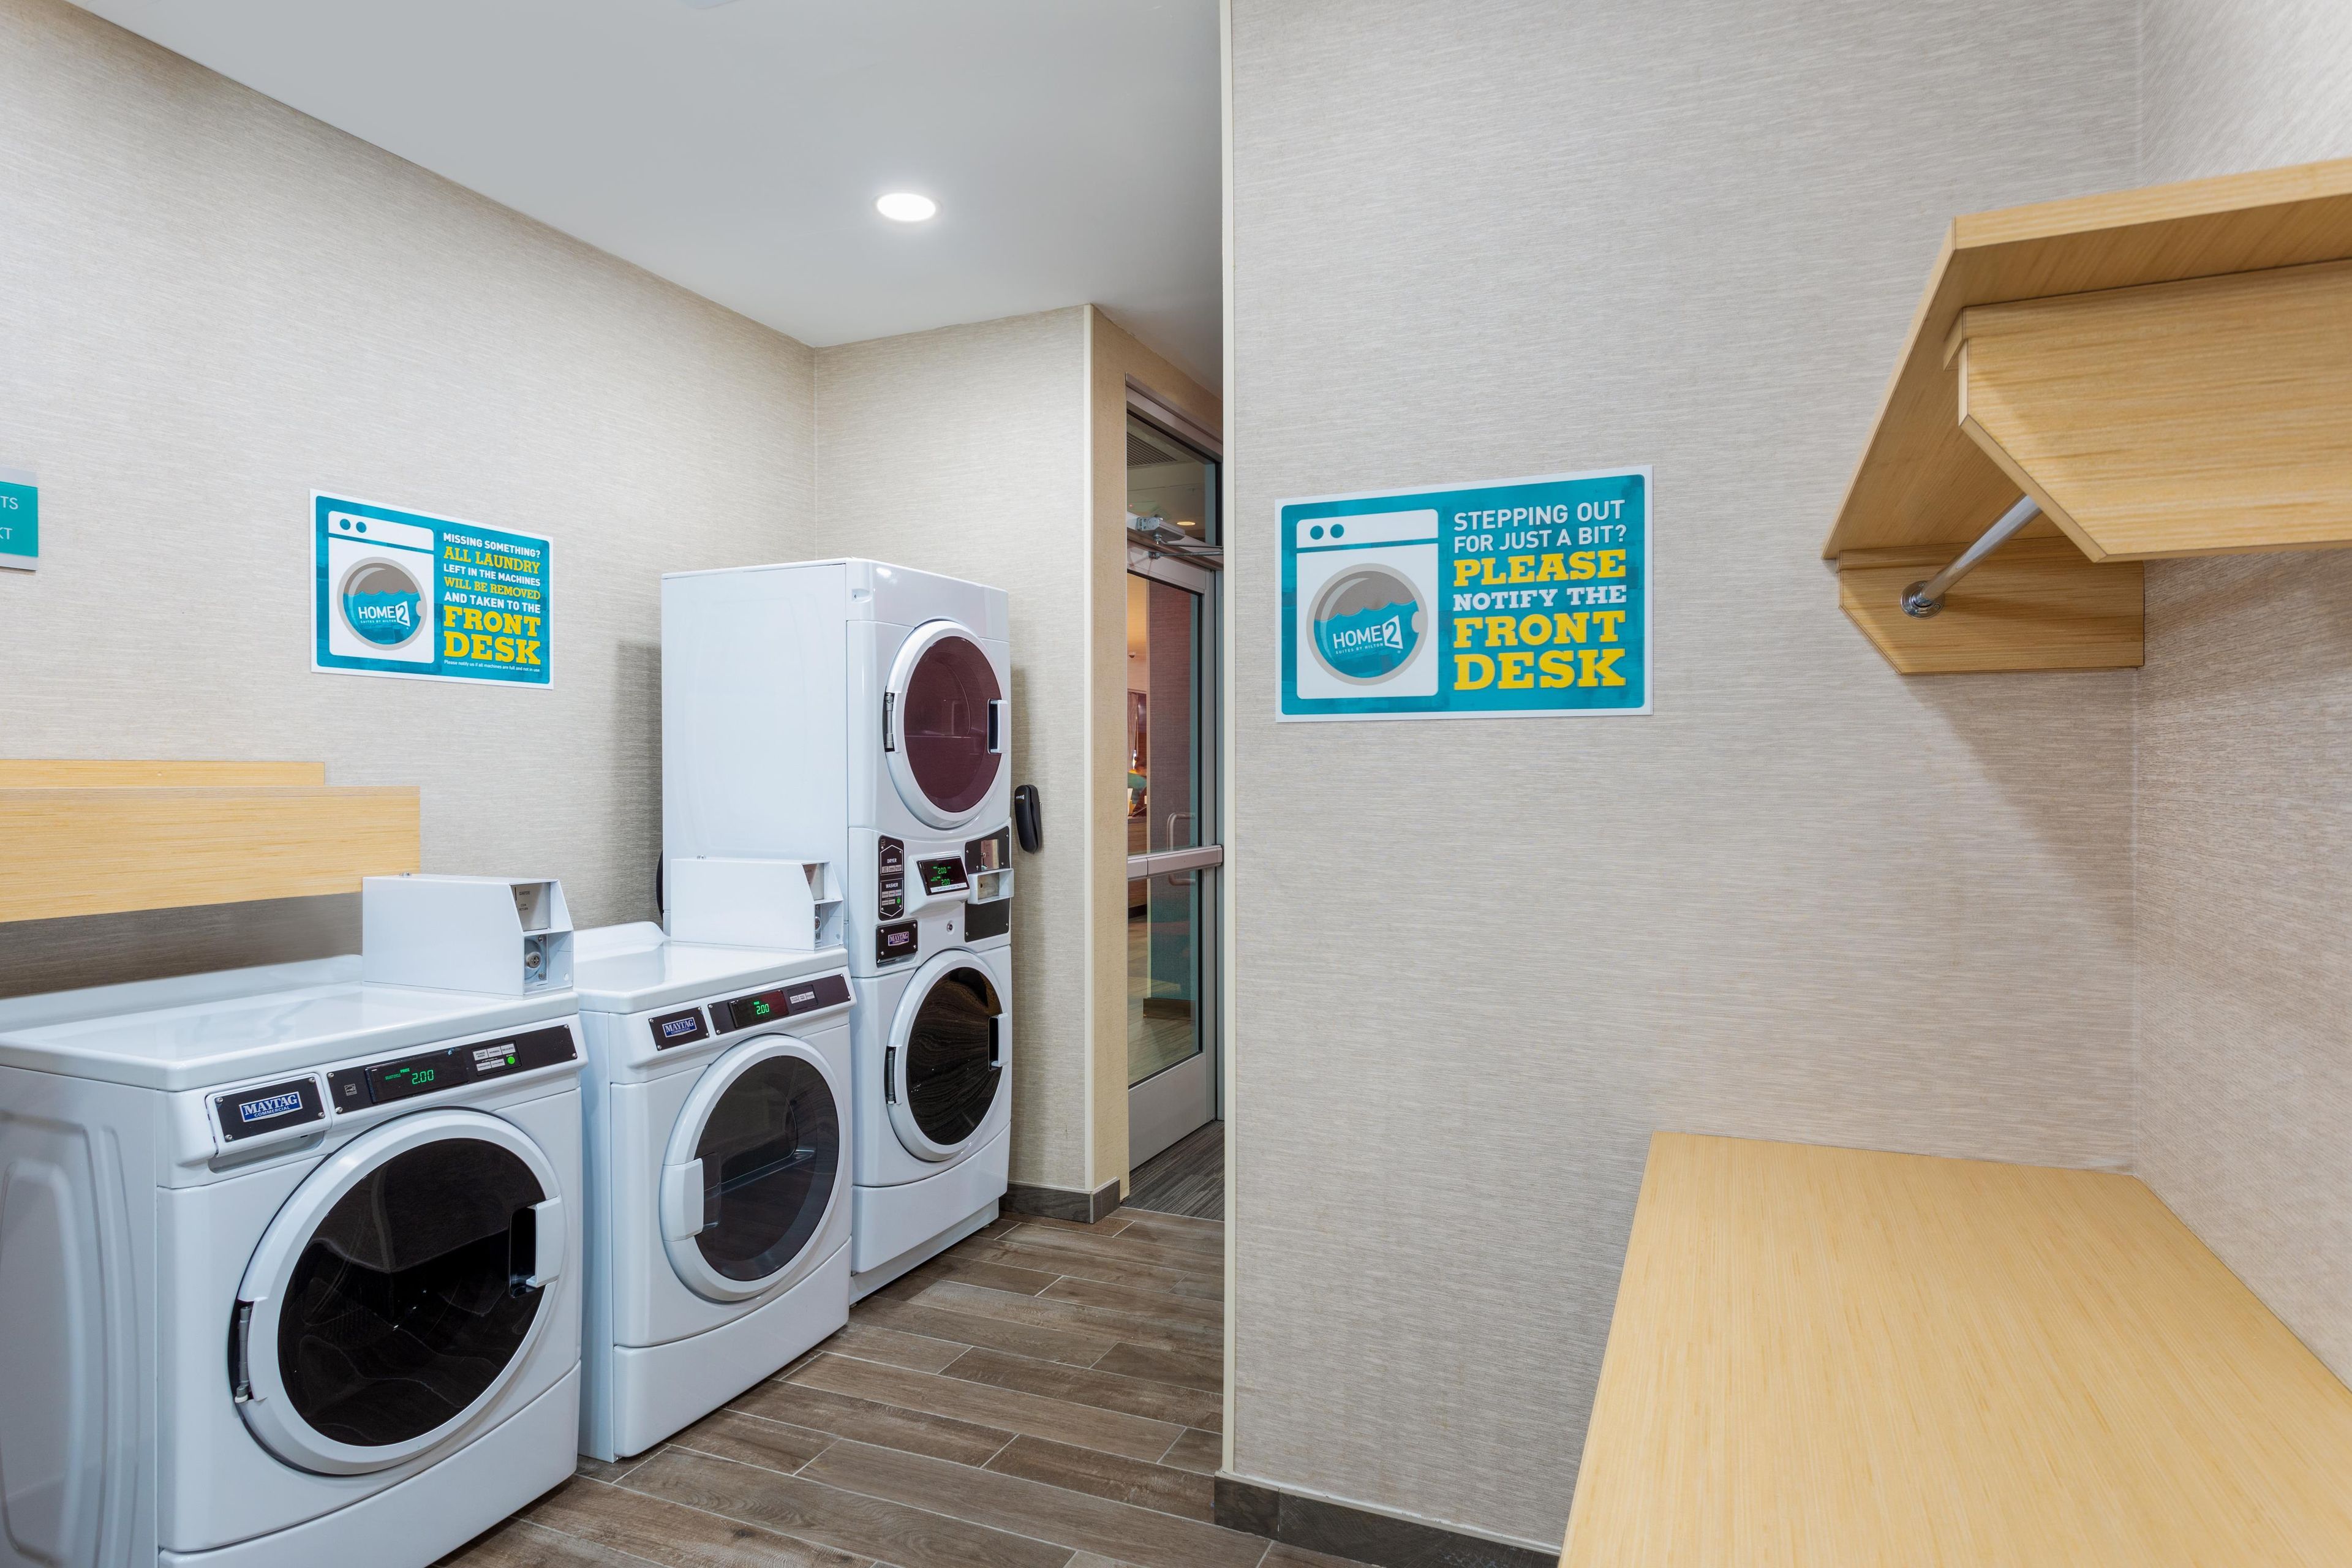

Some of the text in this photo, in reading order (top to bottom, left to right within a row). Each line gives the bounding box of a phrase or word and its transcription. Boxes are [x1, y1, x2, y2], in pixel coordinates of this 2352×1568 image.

[1453, 499, 1625, 532] STEPPING OUT
[443, 532, 541, 559] MISSING SOMETHING?
[1454, 524, 1627, 554] FOR JUST A BIT?
[443, 546, 541, 574] ALL LAUNDRY
[1453, 549, 1626, 587] PLEASE
[443, 564, 541, 587] LEFT IN THE MACHINES
[443, 576, 541, 600] WILL BE REMOVED
[444, 591, 541, 614] AND TAKEN TO THE
[1453, 585, 1627, 611] NOTIFY THE
[443, 605, 541, 637] FRONT
[1453, 610, 1626, 648] FRONT
[443, 630, 541, 665] DESK
[1453, 648, 1626, 690] DESK
[889, 933, 908, 942] MAYTAG
[756, 1003, 770, 1015] 2.00
[665, 1019, 693, 1033] MAYTAG
[412, 1069, 434, 1085] 2.00
[243, 1095, 298, 1115] MAYTAG
[254, 1106, 290, 1117] COMMERCIAL
